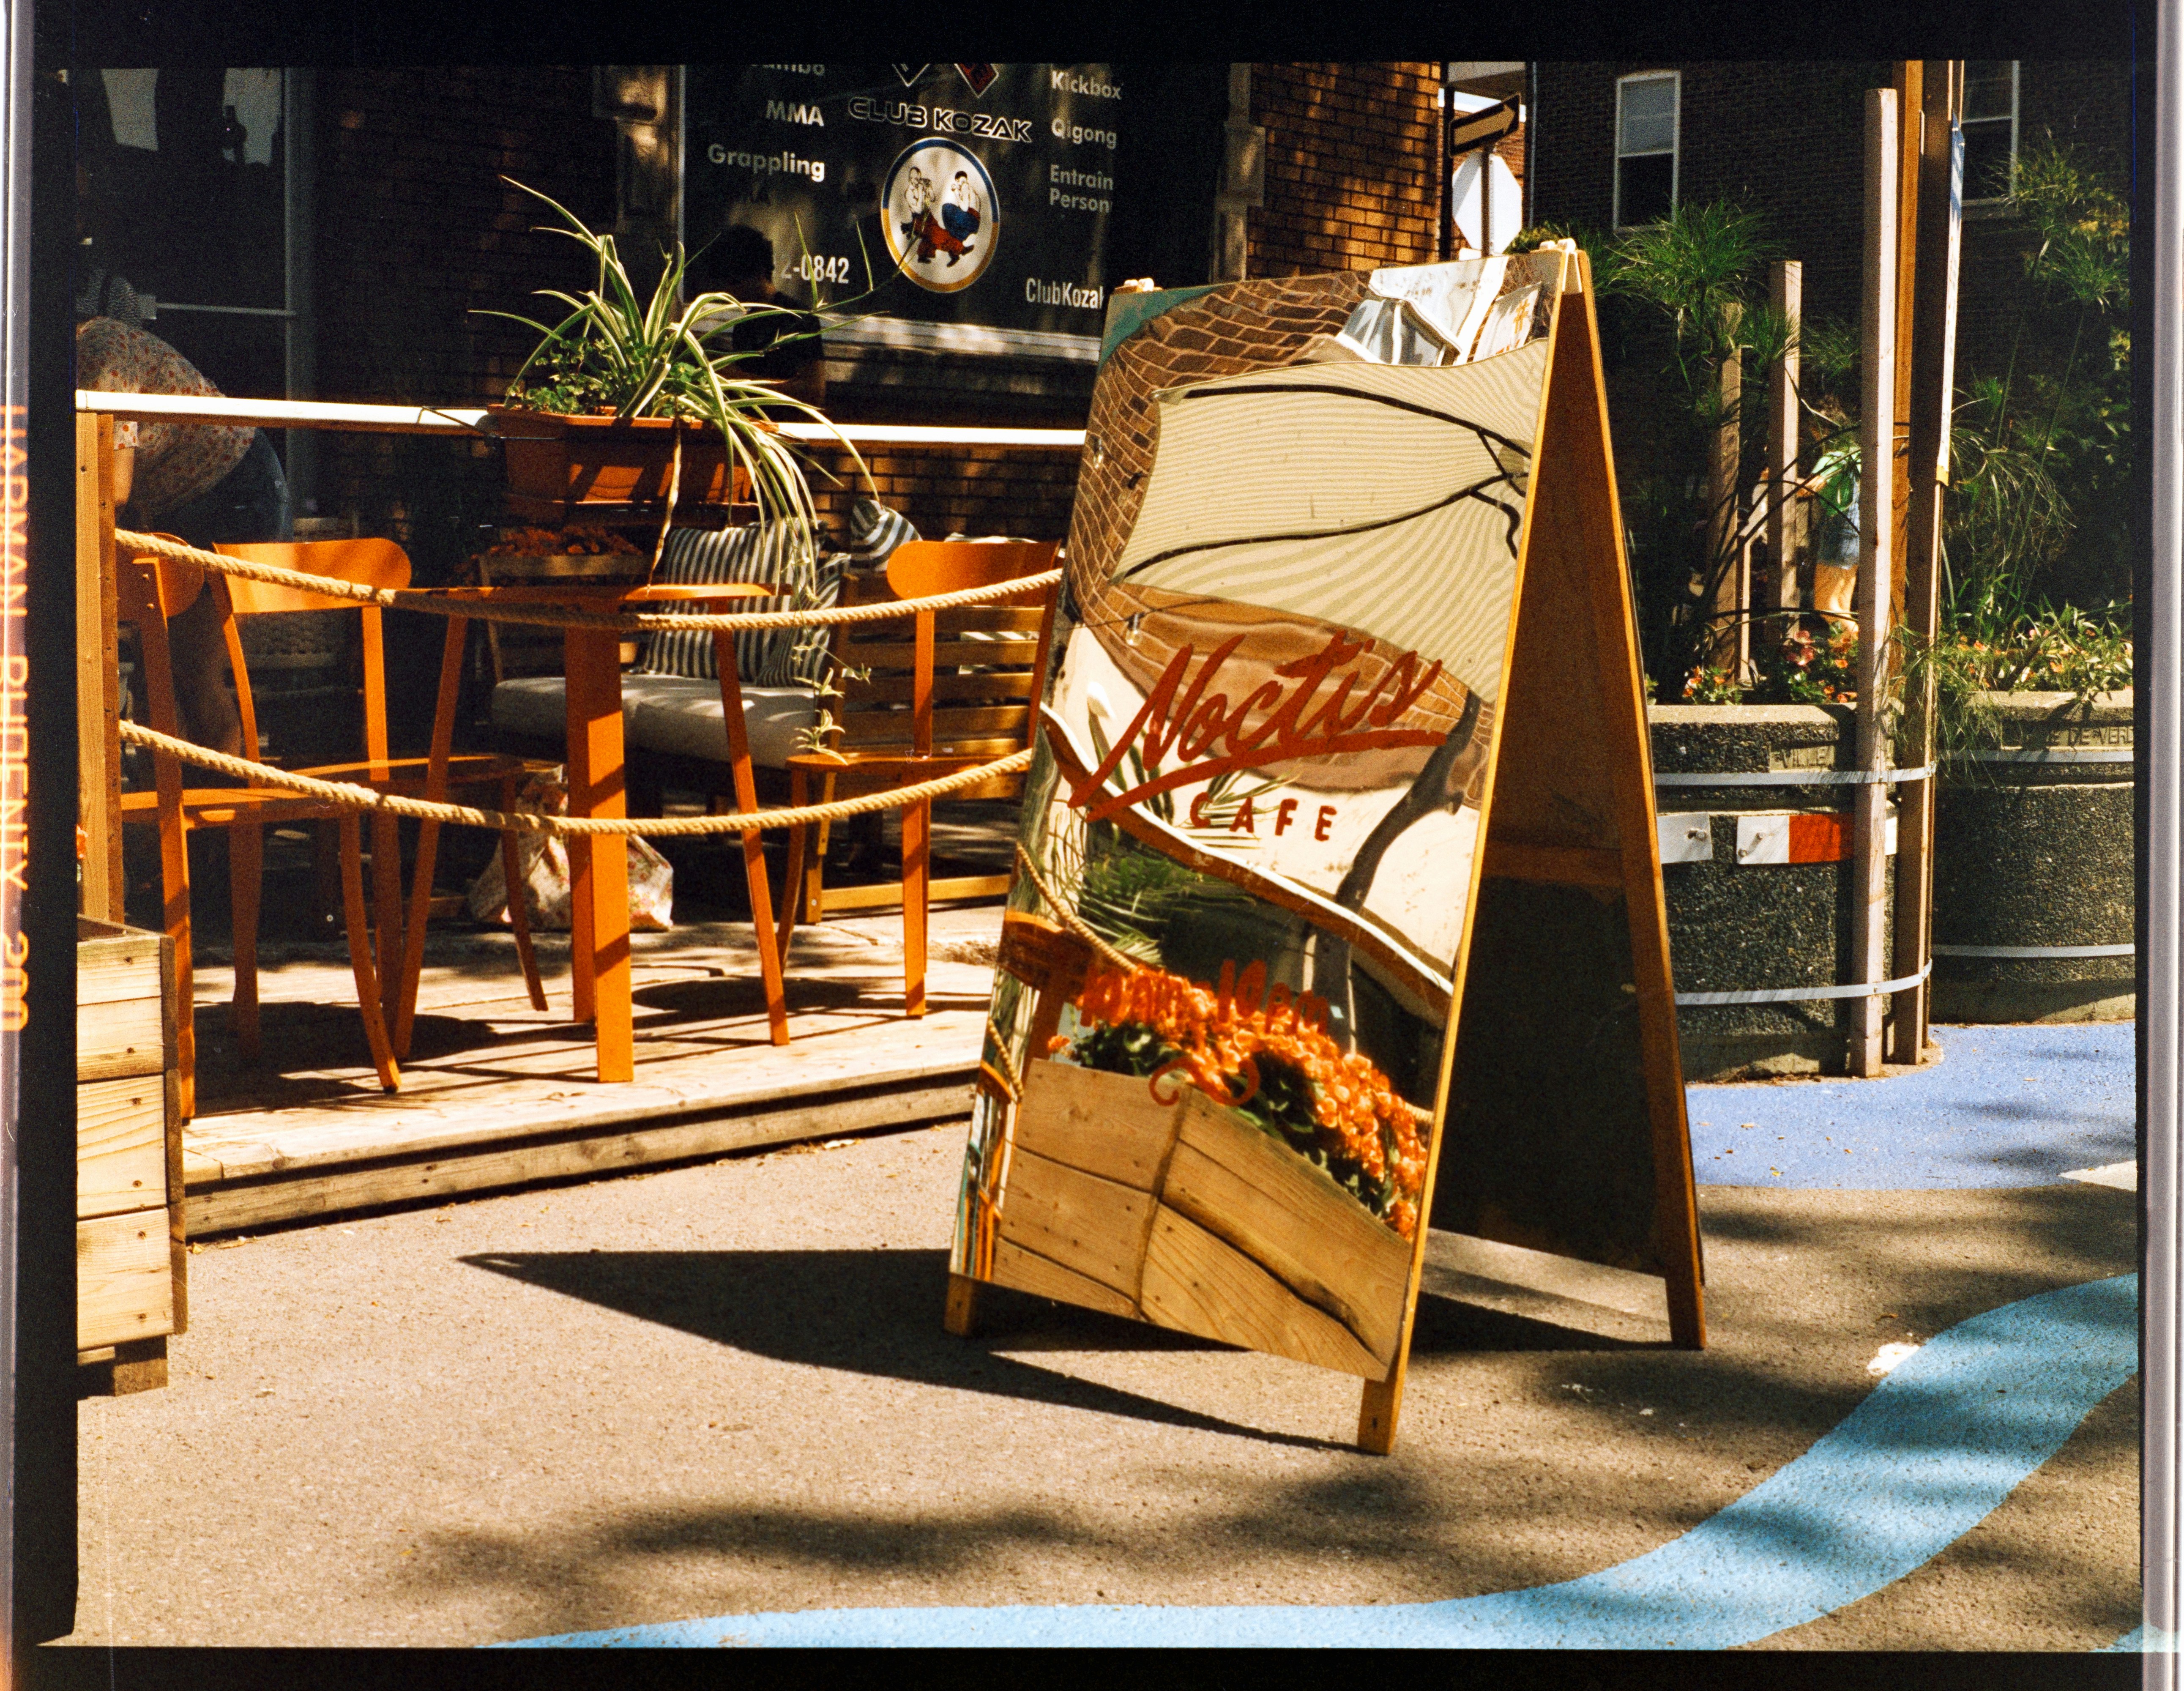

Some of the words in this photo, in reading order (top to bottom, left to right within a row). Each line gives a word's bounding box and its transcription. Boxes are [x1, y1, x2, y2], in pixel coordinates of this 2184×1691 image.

[1051, 70, 1122, 100] Kickbox
[765, 100, 824, 126] MMA
[848, 97, 927, 128] CLUB
[934, 107, 1032, 143] KOZAK
[1051, 118, 1117, 150] Qigong
[708, 144, 825, 182] Grappling
[1068, 630, 1444, 809] Noctis
[1189, 791, 1337, 842] CAFE
